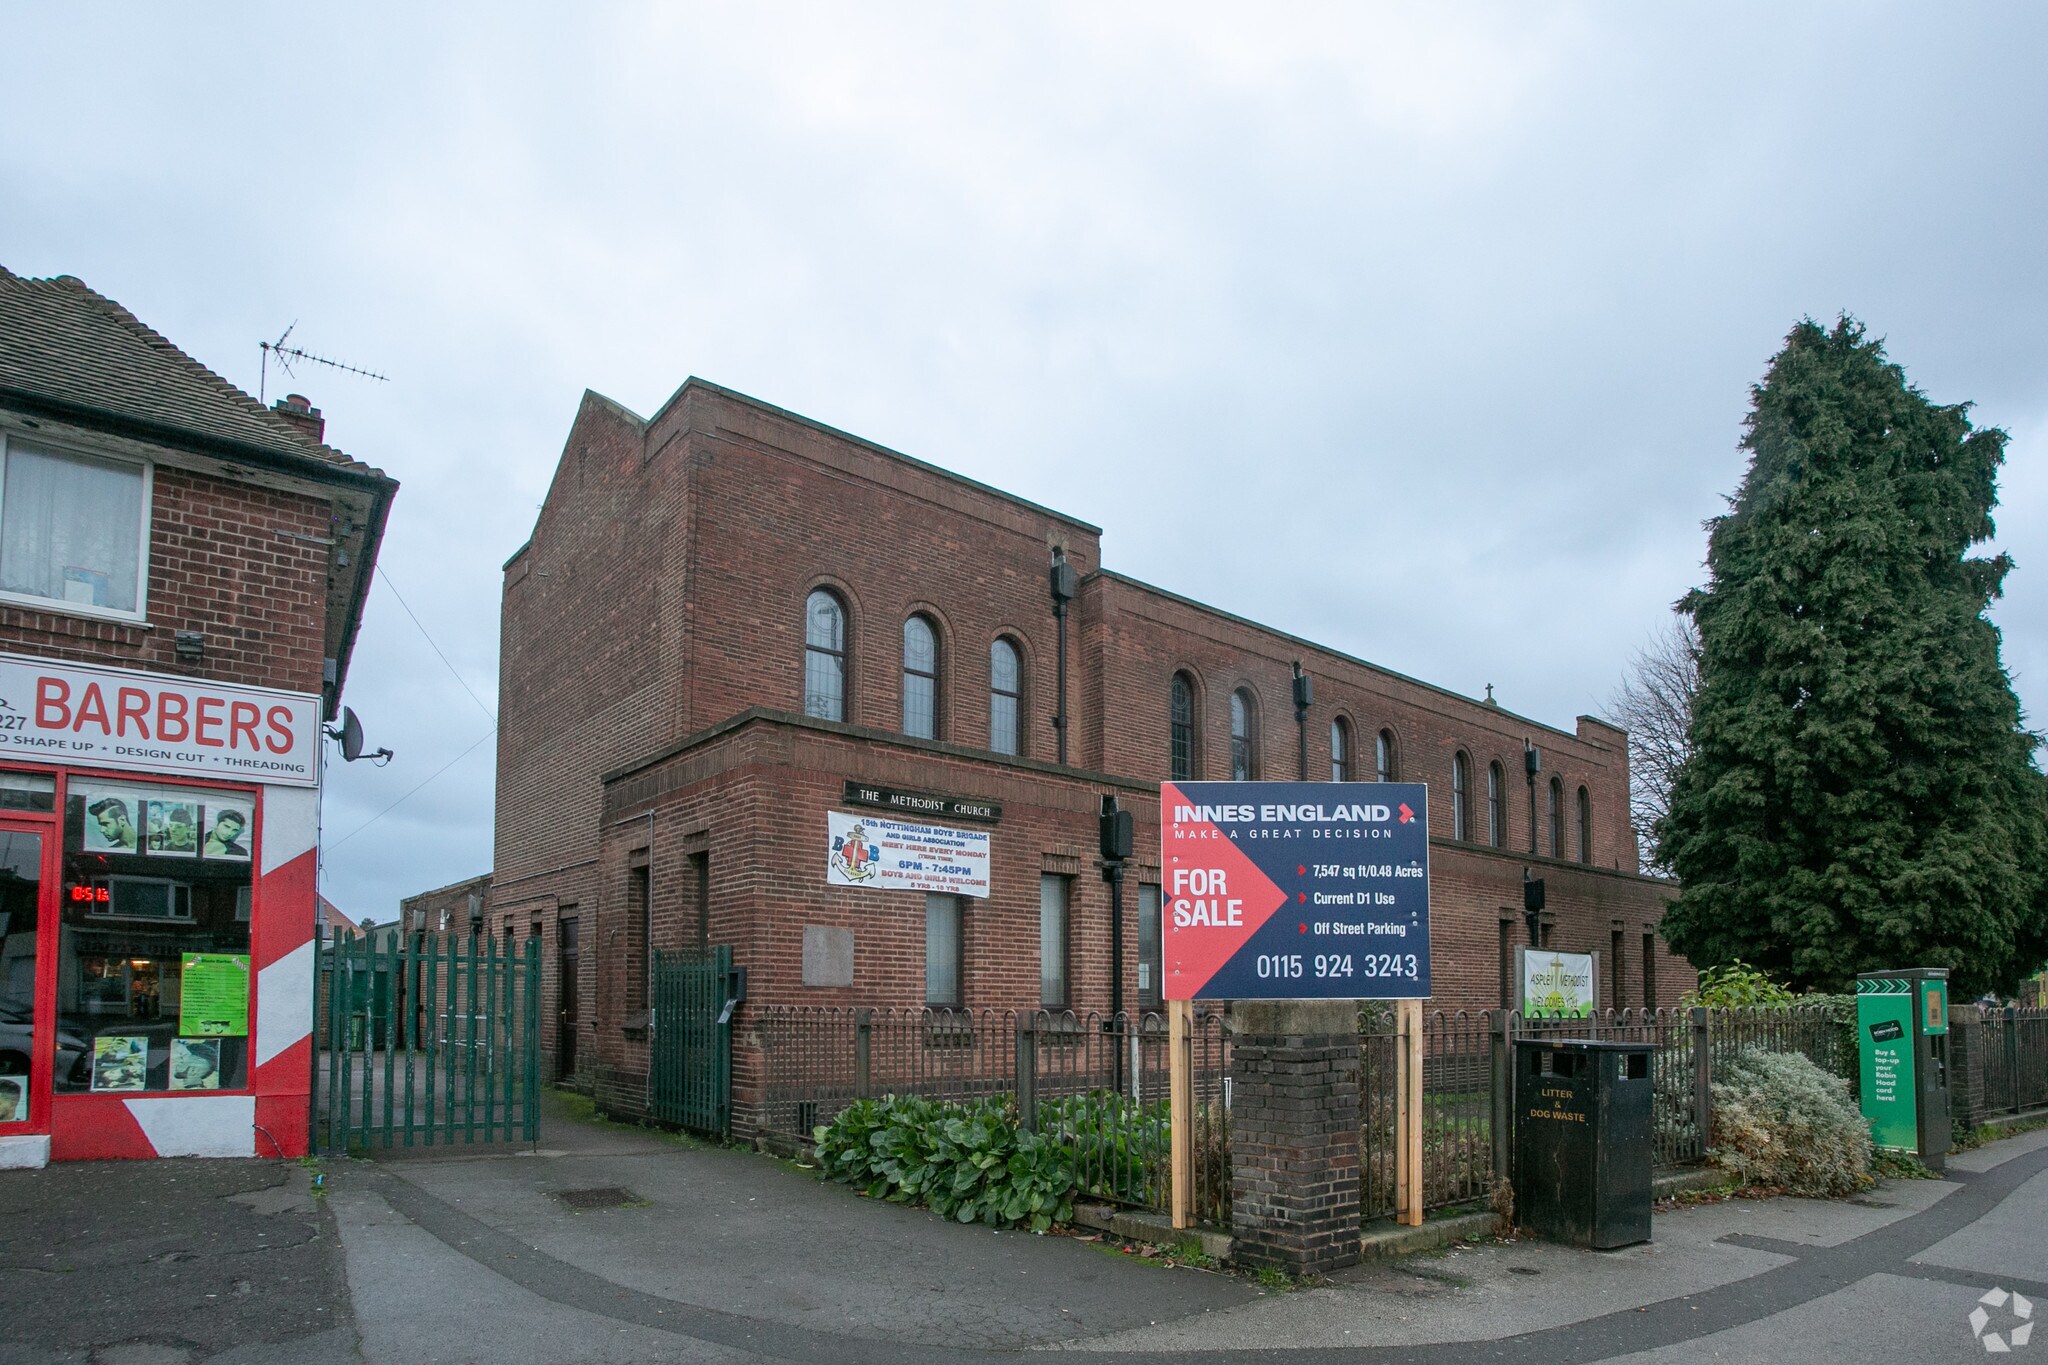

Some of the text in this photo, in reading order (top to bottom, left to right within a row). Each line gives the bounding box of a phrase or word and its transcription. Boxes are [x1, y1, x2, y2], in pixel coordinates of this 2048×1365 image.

[35, 676, 293, 755] BARBERS
[13, 735, 67, 749] SHAPE
[72, 741, 94, 751] UP
[115, 746, 171, 760] DESIGN
[176, 752, 205, 763] CUT
[224, 757, 305, 773] THREADING
[860, 789, 990, 817] THE METHODIST CHURCH
[1174, 804, 1391, 823] INNES ENGLAND
[880, 821, 932, 835] NOTTINGHAM
[956, 831, 988, 841] BRIGADE
[1174, 828, 1393, 840] MAKE A GREAT DECISION
[832, 836, 845, 852] B
[886, 832, 901, 840] AND
[923, 836, 965, 848] ASSOCIATION
[869, 844, 880, 862] B
[905, 844, 928, 853] HERE
[929, 846, 954, 856] EVERY
[955, 850, 987, 859] MONDAY
[899, 860, 923, 871] 6PM
[932, 863, 972, 876] 7:45PM
[1312, 864, 1424, 880] 7,547 sq ft/0.48 Acres
[881, 870, 904, 879] BOYS
[905, 873, 923, 881] AND
[949, 876, 987, 887] WELCOME
[1173, 868, 1228, 897] FOR
[1313, 892, 1396, 905] Current D1 Use
[1173, 899, 1244, 927] SALE
[1313, 922, 1407, 938] Off Street Parking
[1256, 954, 1418, 979] 0115 924 3243
[1530, 974, 1553, 986] ASPLEY
[1532, 996, 1566, 1008] WELCOMES
[1541, 1088, 1573, 1098] LITTER
[1554, 1101, 1561, 1109] &
[1530, 1109, 1586, 1122] DOG WASTE
